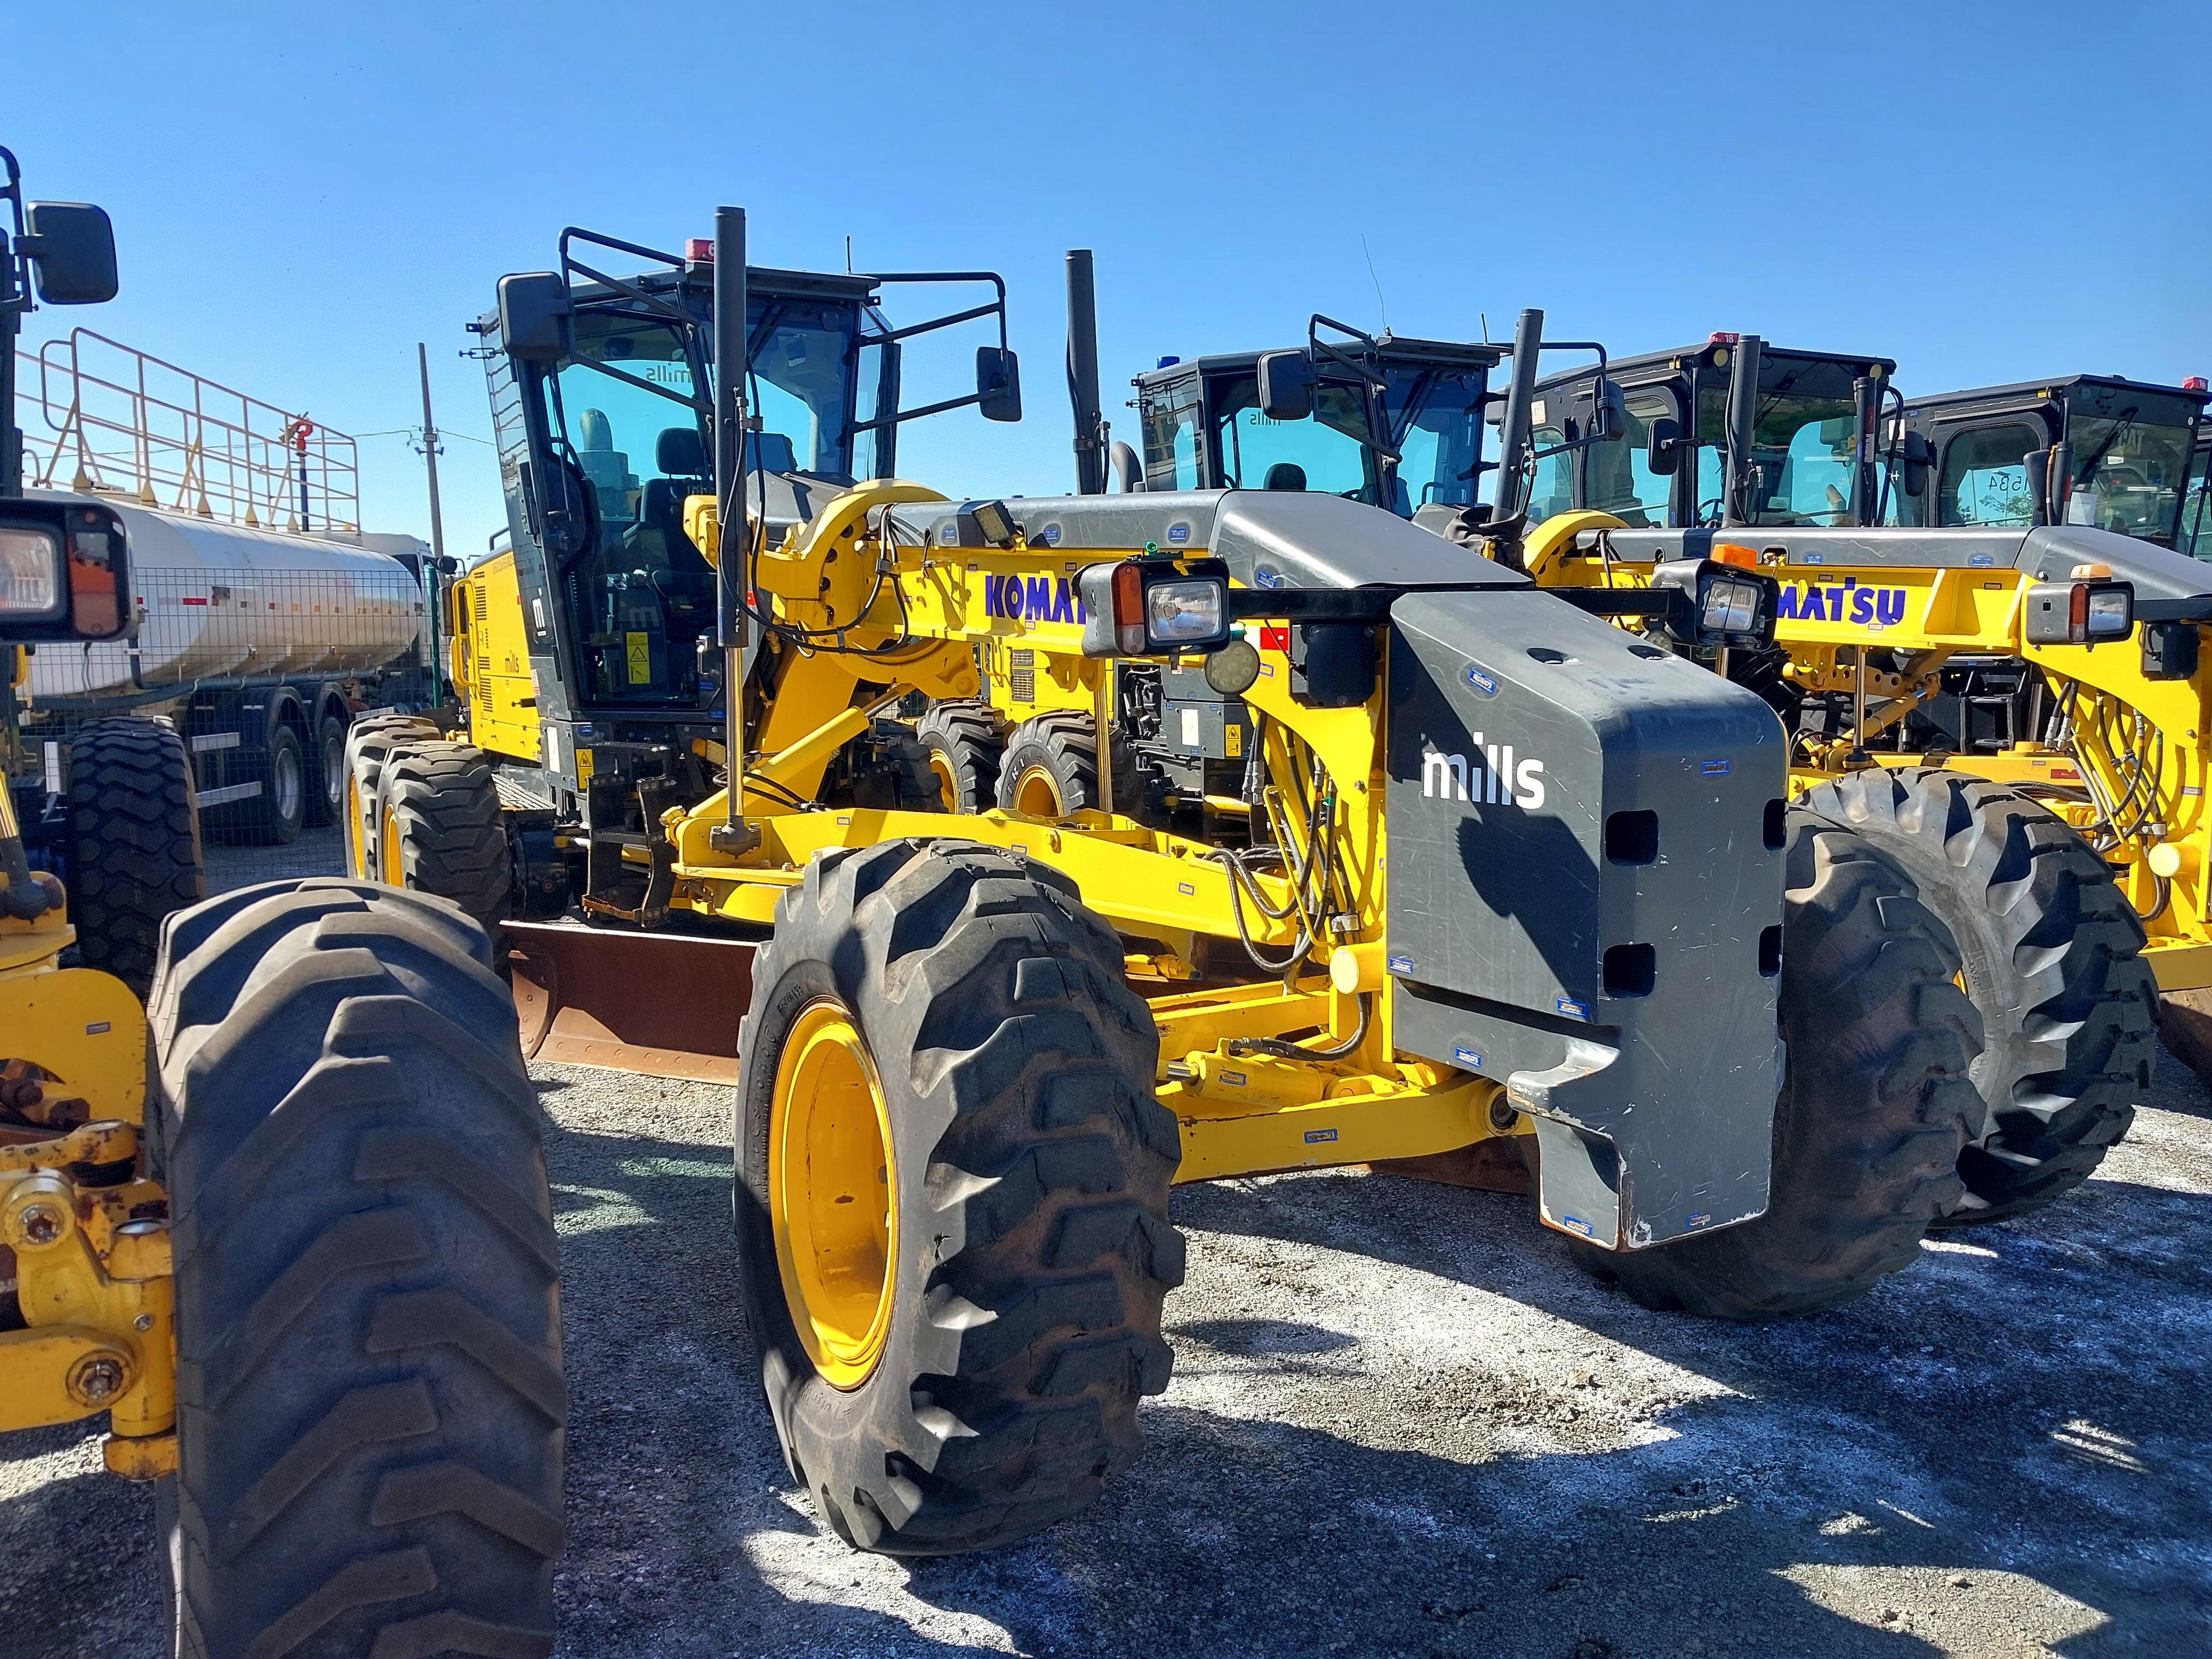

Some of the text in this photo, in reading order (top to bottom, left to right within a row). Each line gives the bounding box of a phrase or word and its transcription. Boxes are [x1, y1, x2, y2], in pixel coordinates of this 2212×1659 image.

[1724, 334, 1734, 343] 18
[2199, 380, 2206, 388] 16
[505, 649, 520, 673] mills
[1423, 730, 1546, 810] mills
